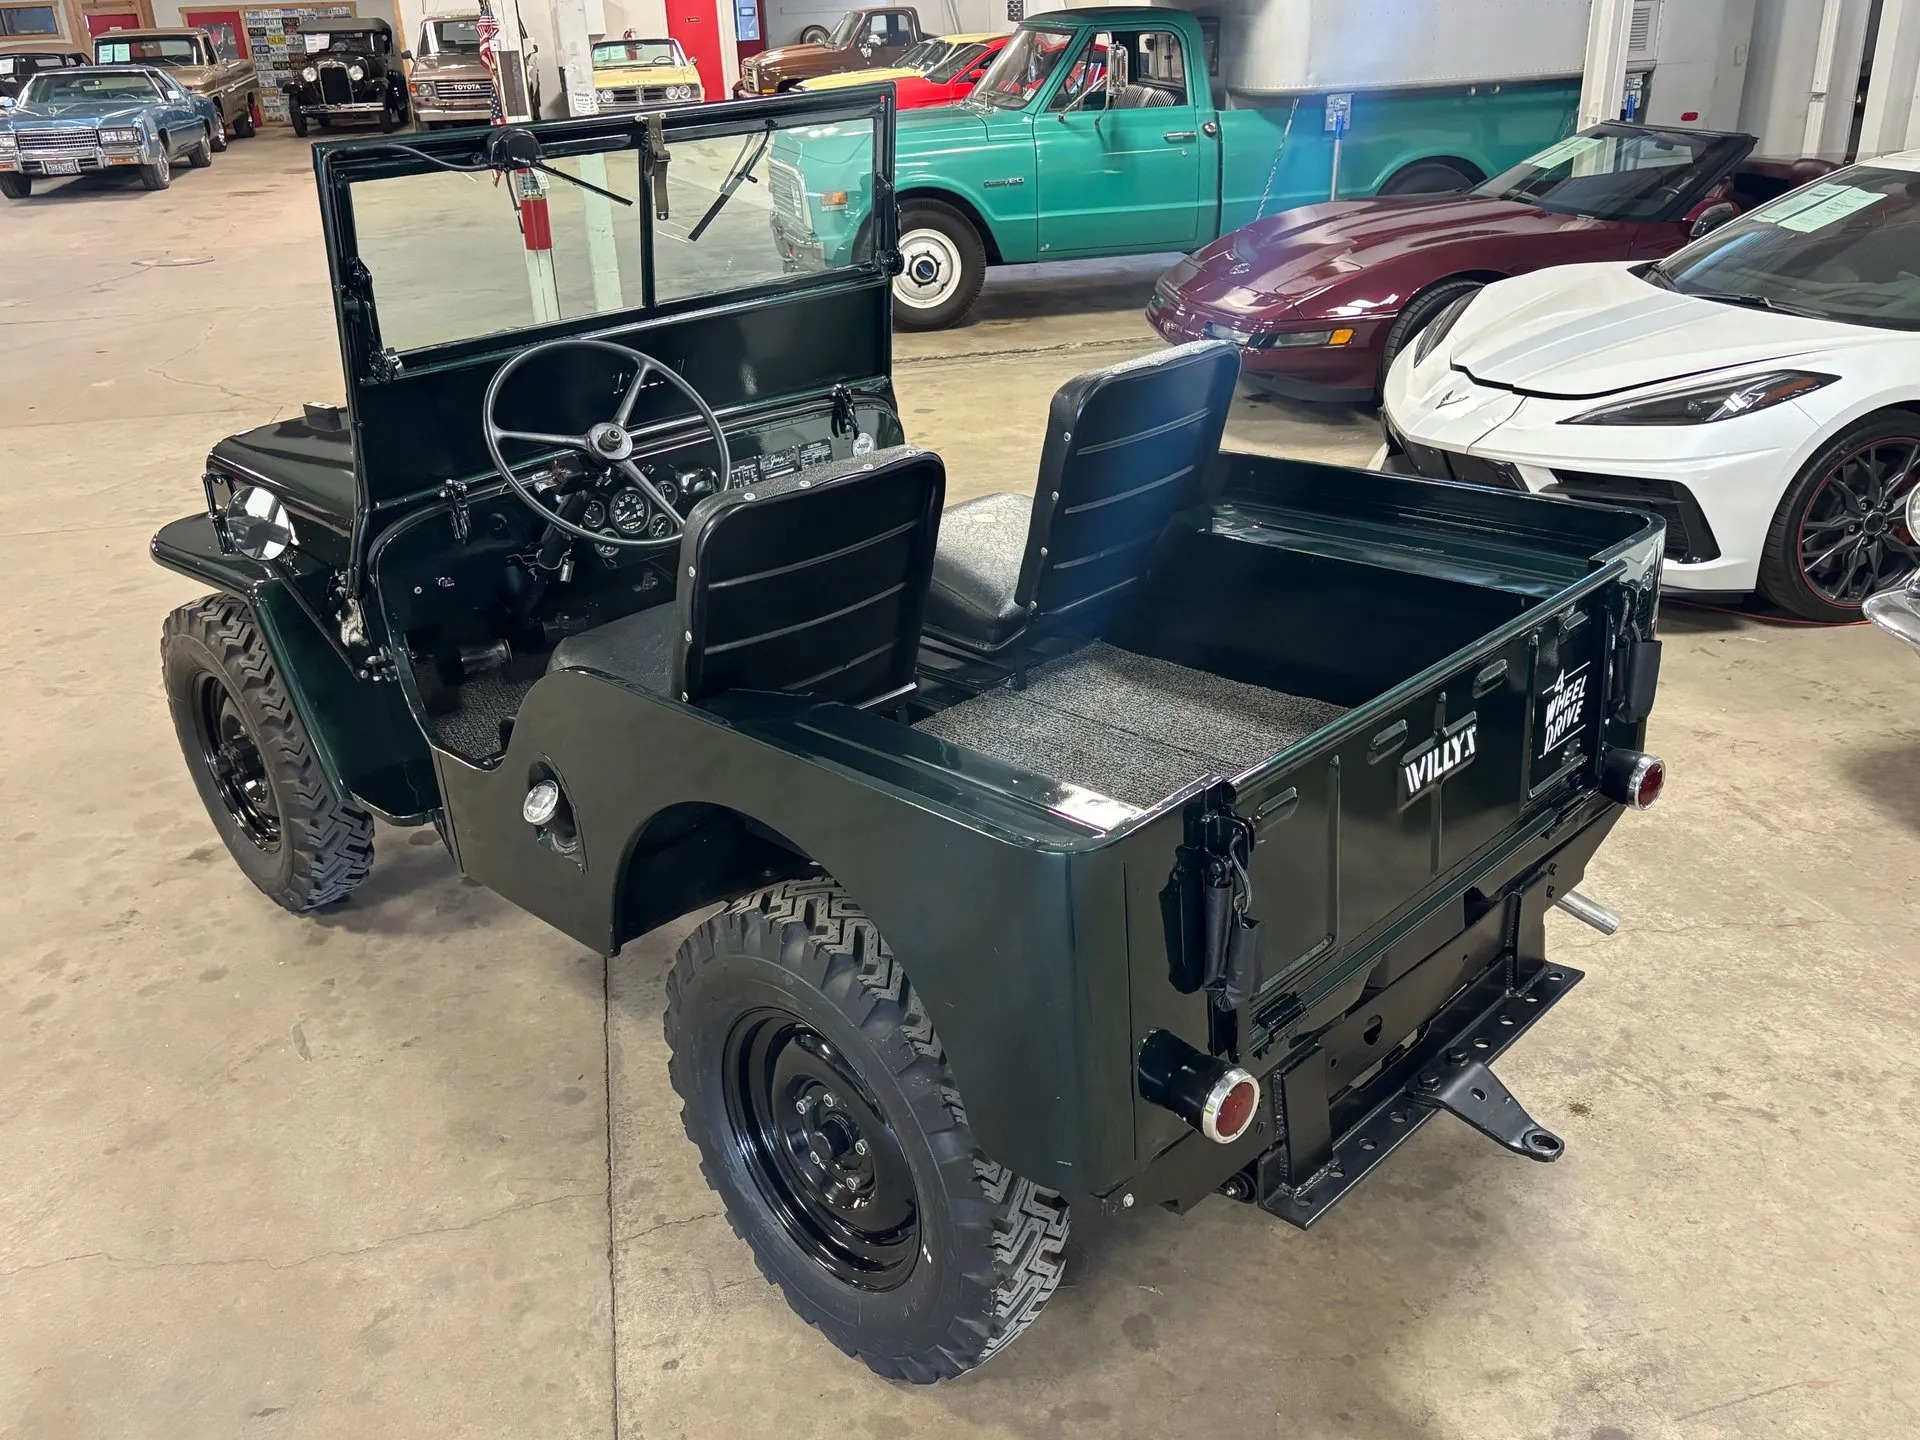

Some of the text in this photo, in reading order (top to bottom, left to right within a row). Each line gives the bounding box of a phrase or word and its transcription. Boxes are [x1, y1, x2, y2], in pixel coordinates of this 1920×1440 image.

[453, 83, 481, 91] TOYOTA
[1545, 674, 1587, 728] WHEEL
[1553, 668, 1565, 693] 4
[1544, 699, 1584, 756] DRIVE
[1404, 724, 1477, 793] WILLYS
